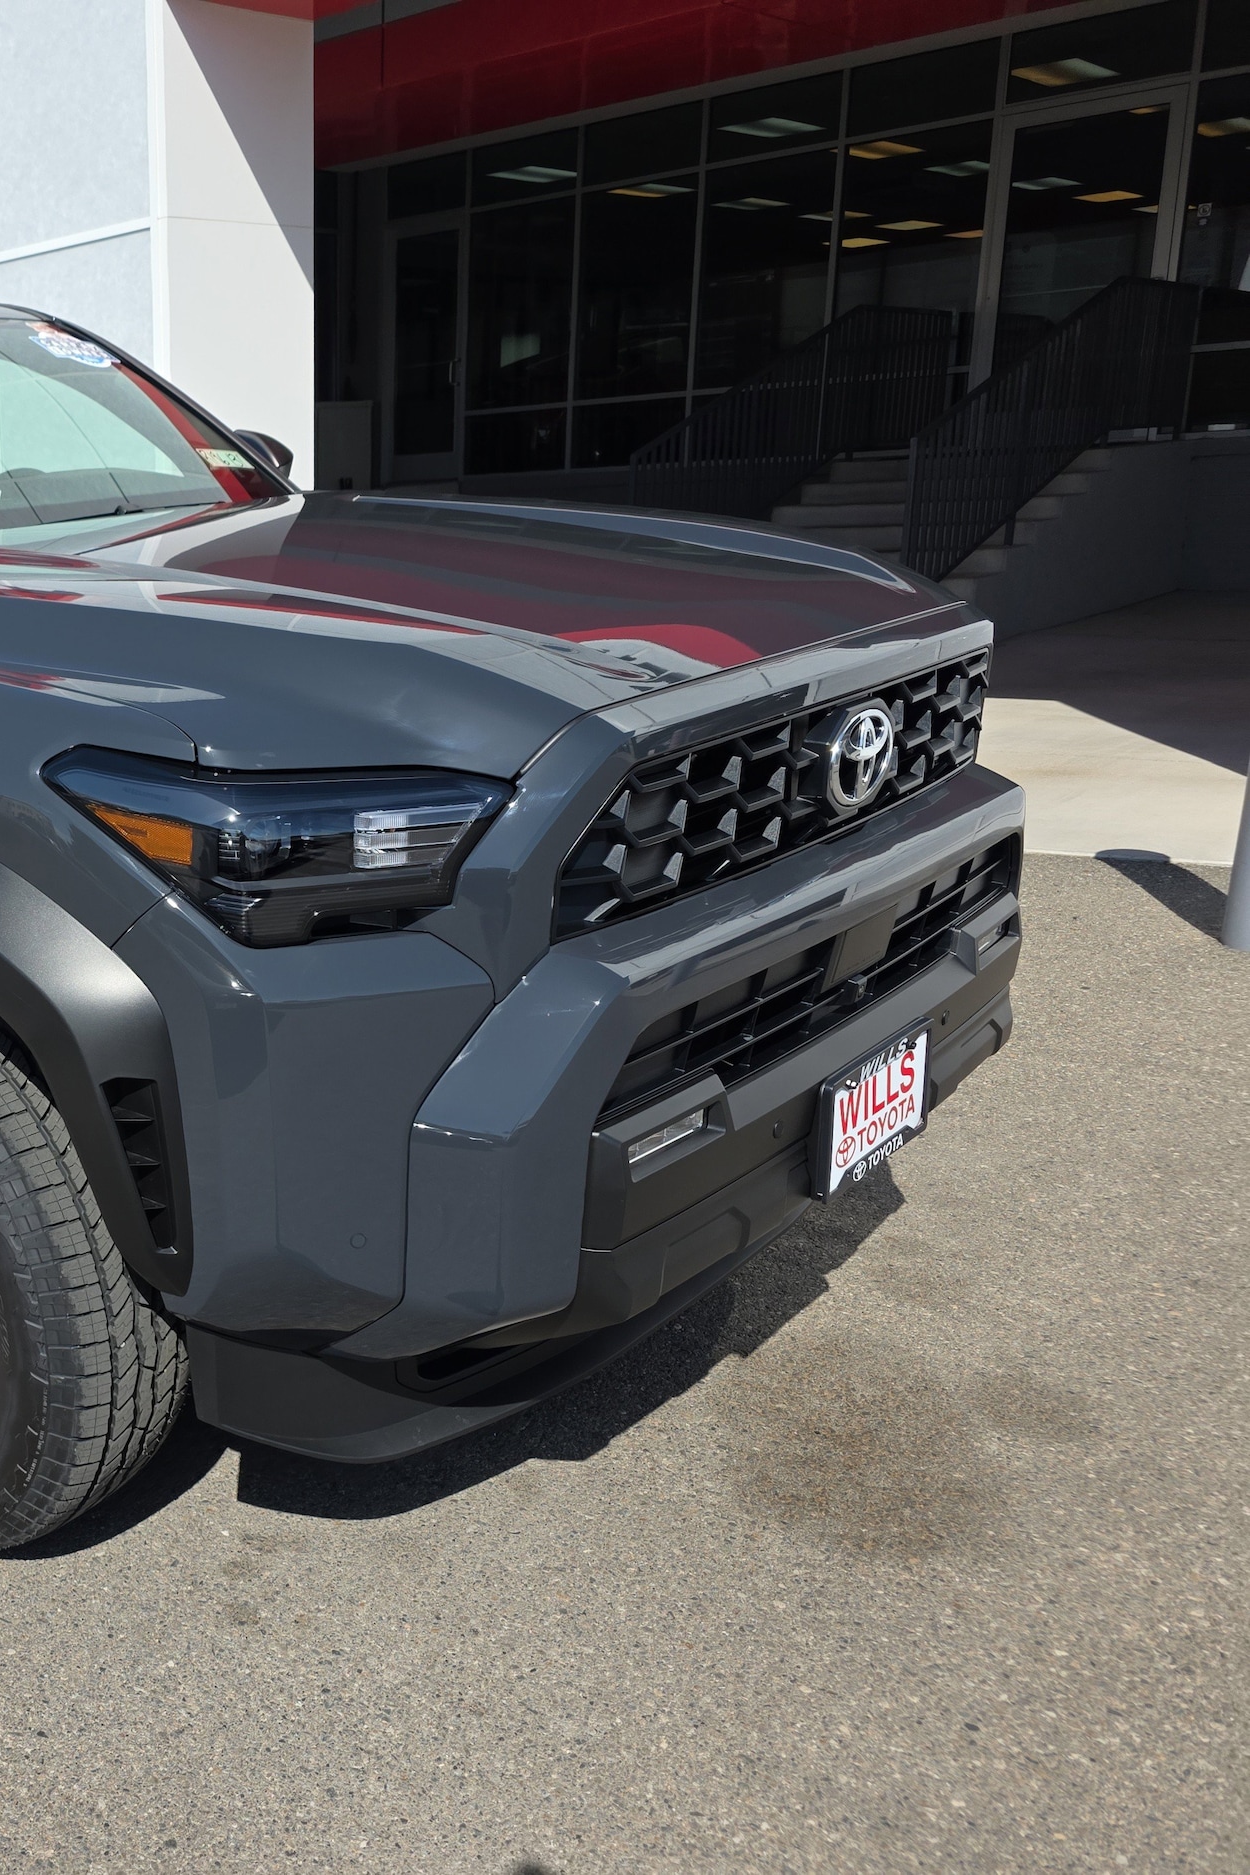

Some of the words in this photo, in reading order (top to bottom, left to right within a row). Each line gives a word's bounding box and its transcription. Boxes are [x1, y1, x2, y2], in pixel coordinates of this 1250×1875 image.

[859, 1037, 909, 1082] WILLS
[839, 1050, 915, 1136] WILLS
[857, 1093, 915, 1153] TOYOTA
[867, 1133, 903, 1170] TOYOTA
